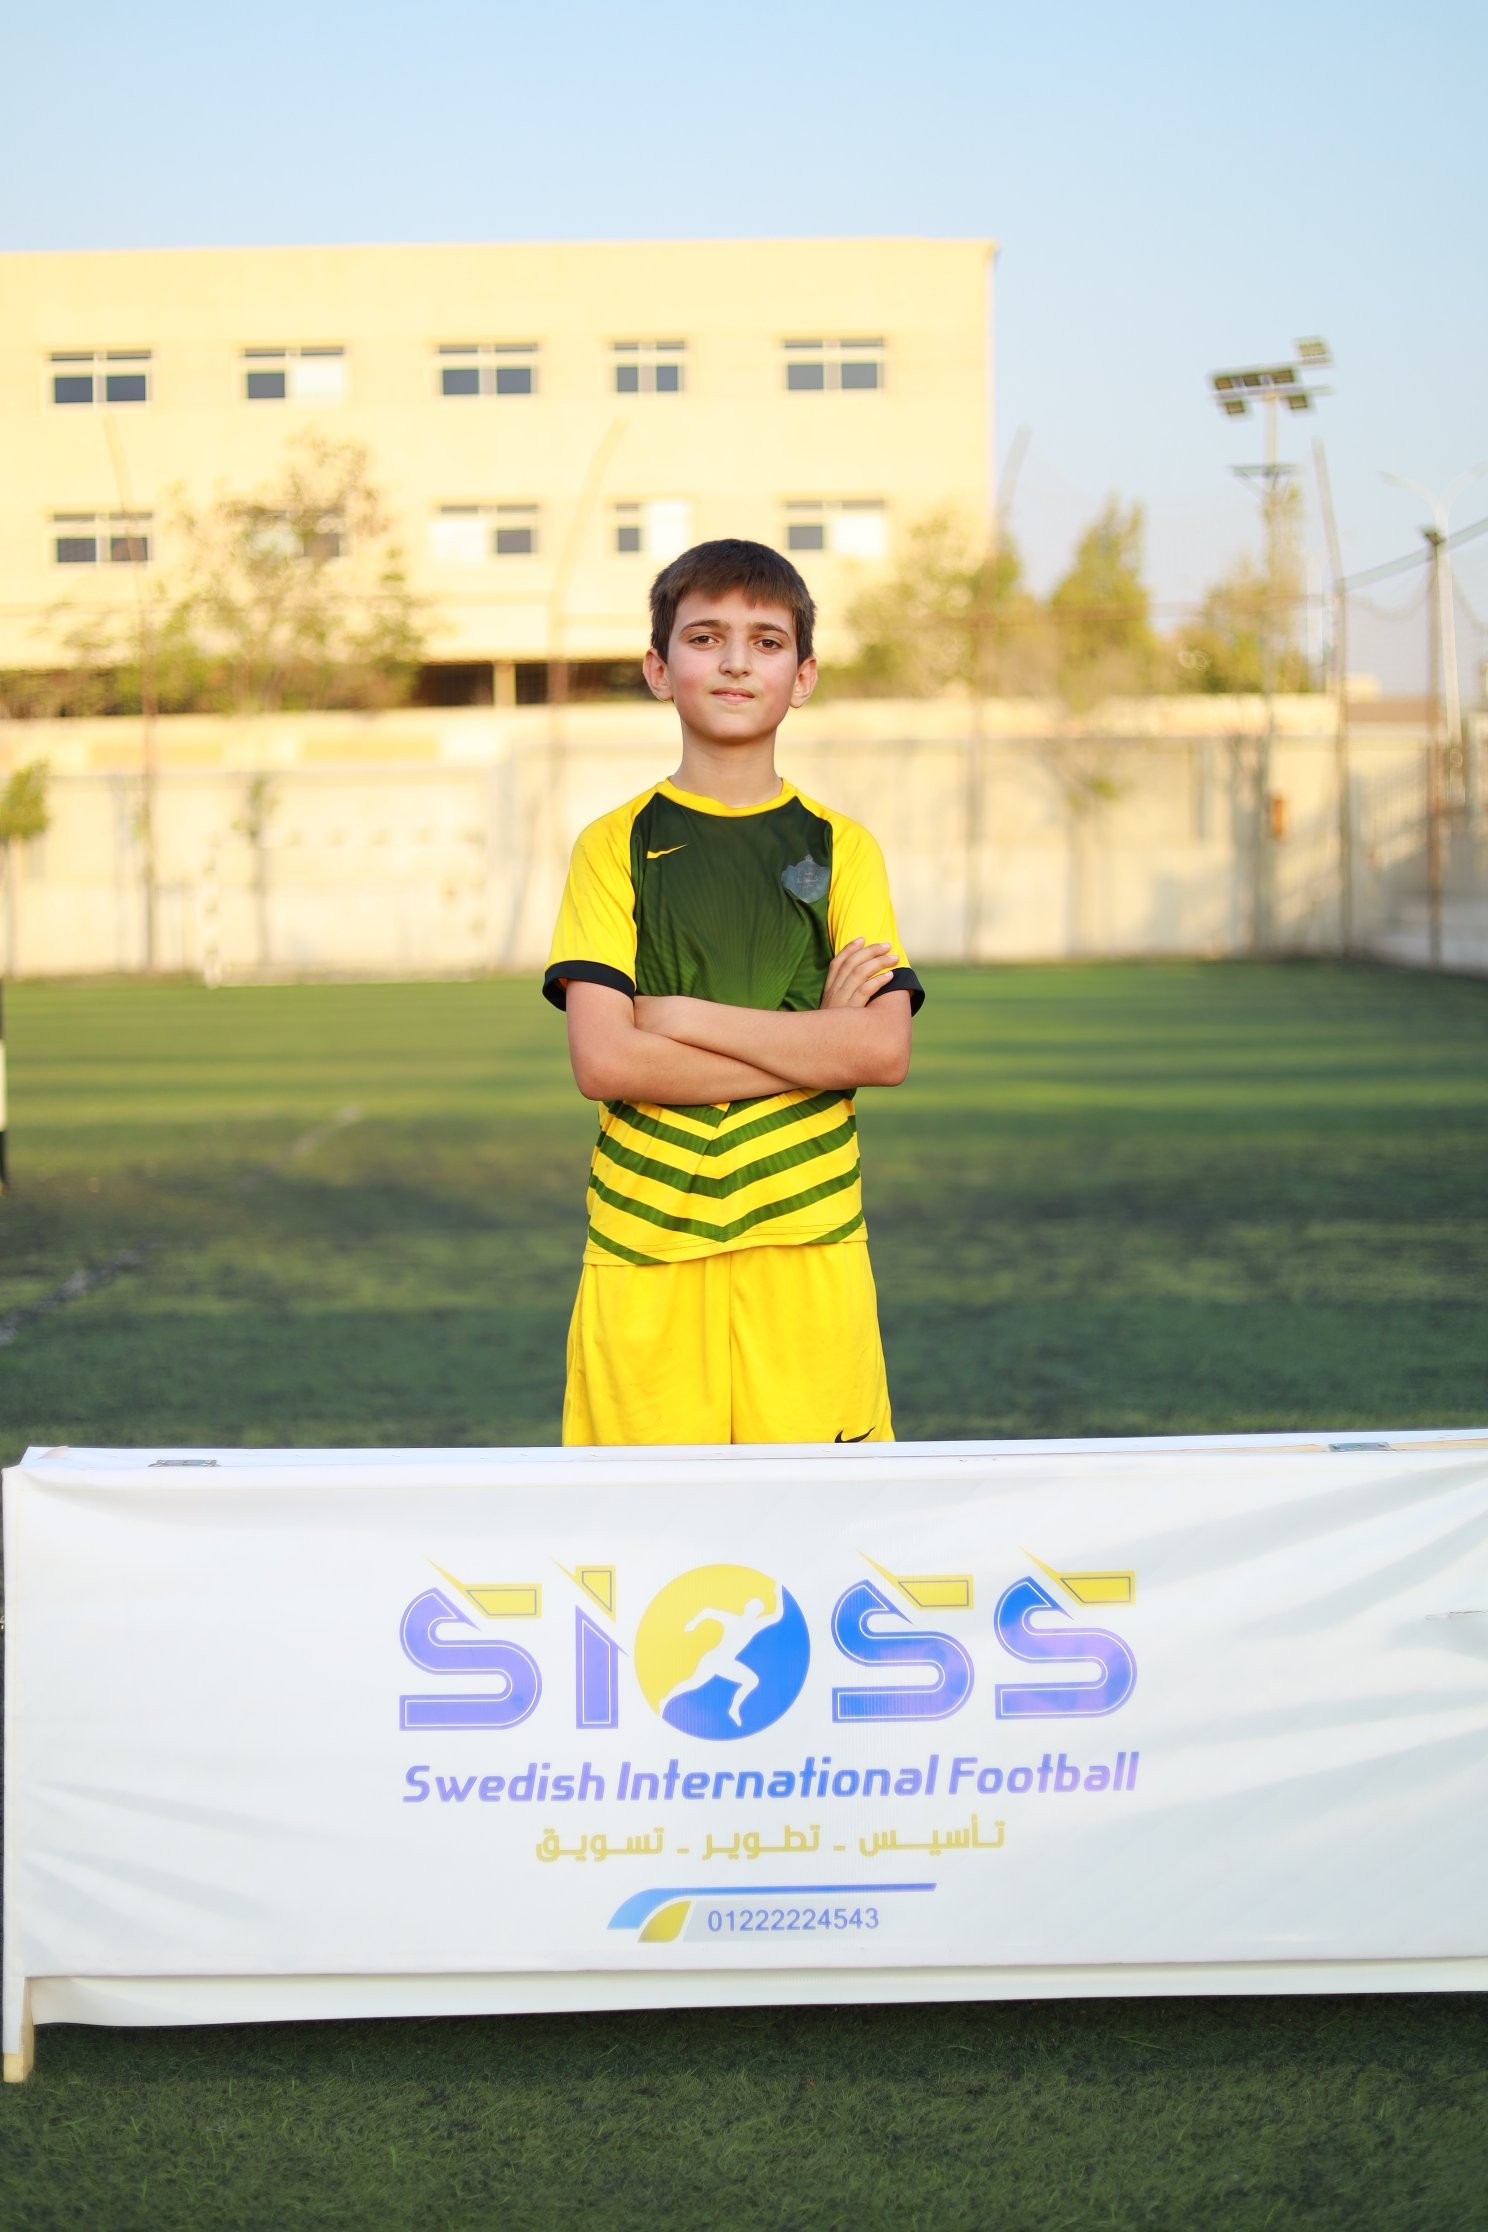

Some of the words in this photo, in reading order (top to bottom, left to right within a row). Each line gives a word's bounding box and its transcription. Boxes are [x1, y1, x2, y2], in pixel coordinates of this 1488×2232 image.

[403, 1762, 605, 1802] Swedish
[617, 1753, 940, 1801] International
[948, 1751, 1140, 1794] Football
[535, 1827, 664, 1862] تسويق
[703, 1824, 820, 1860] تطوير
[706, 1906, 880, 1933] 01222224543
